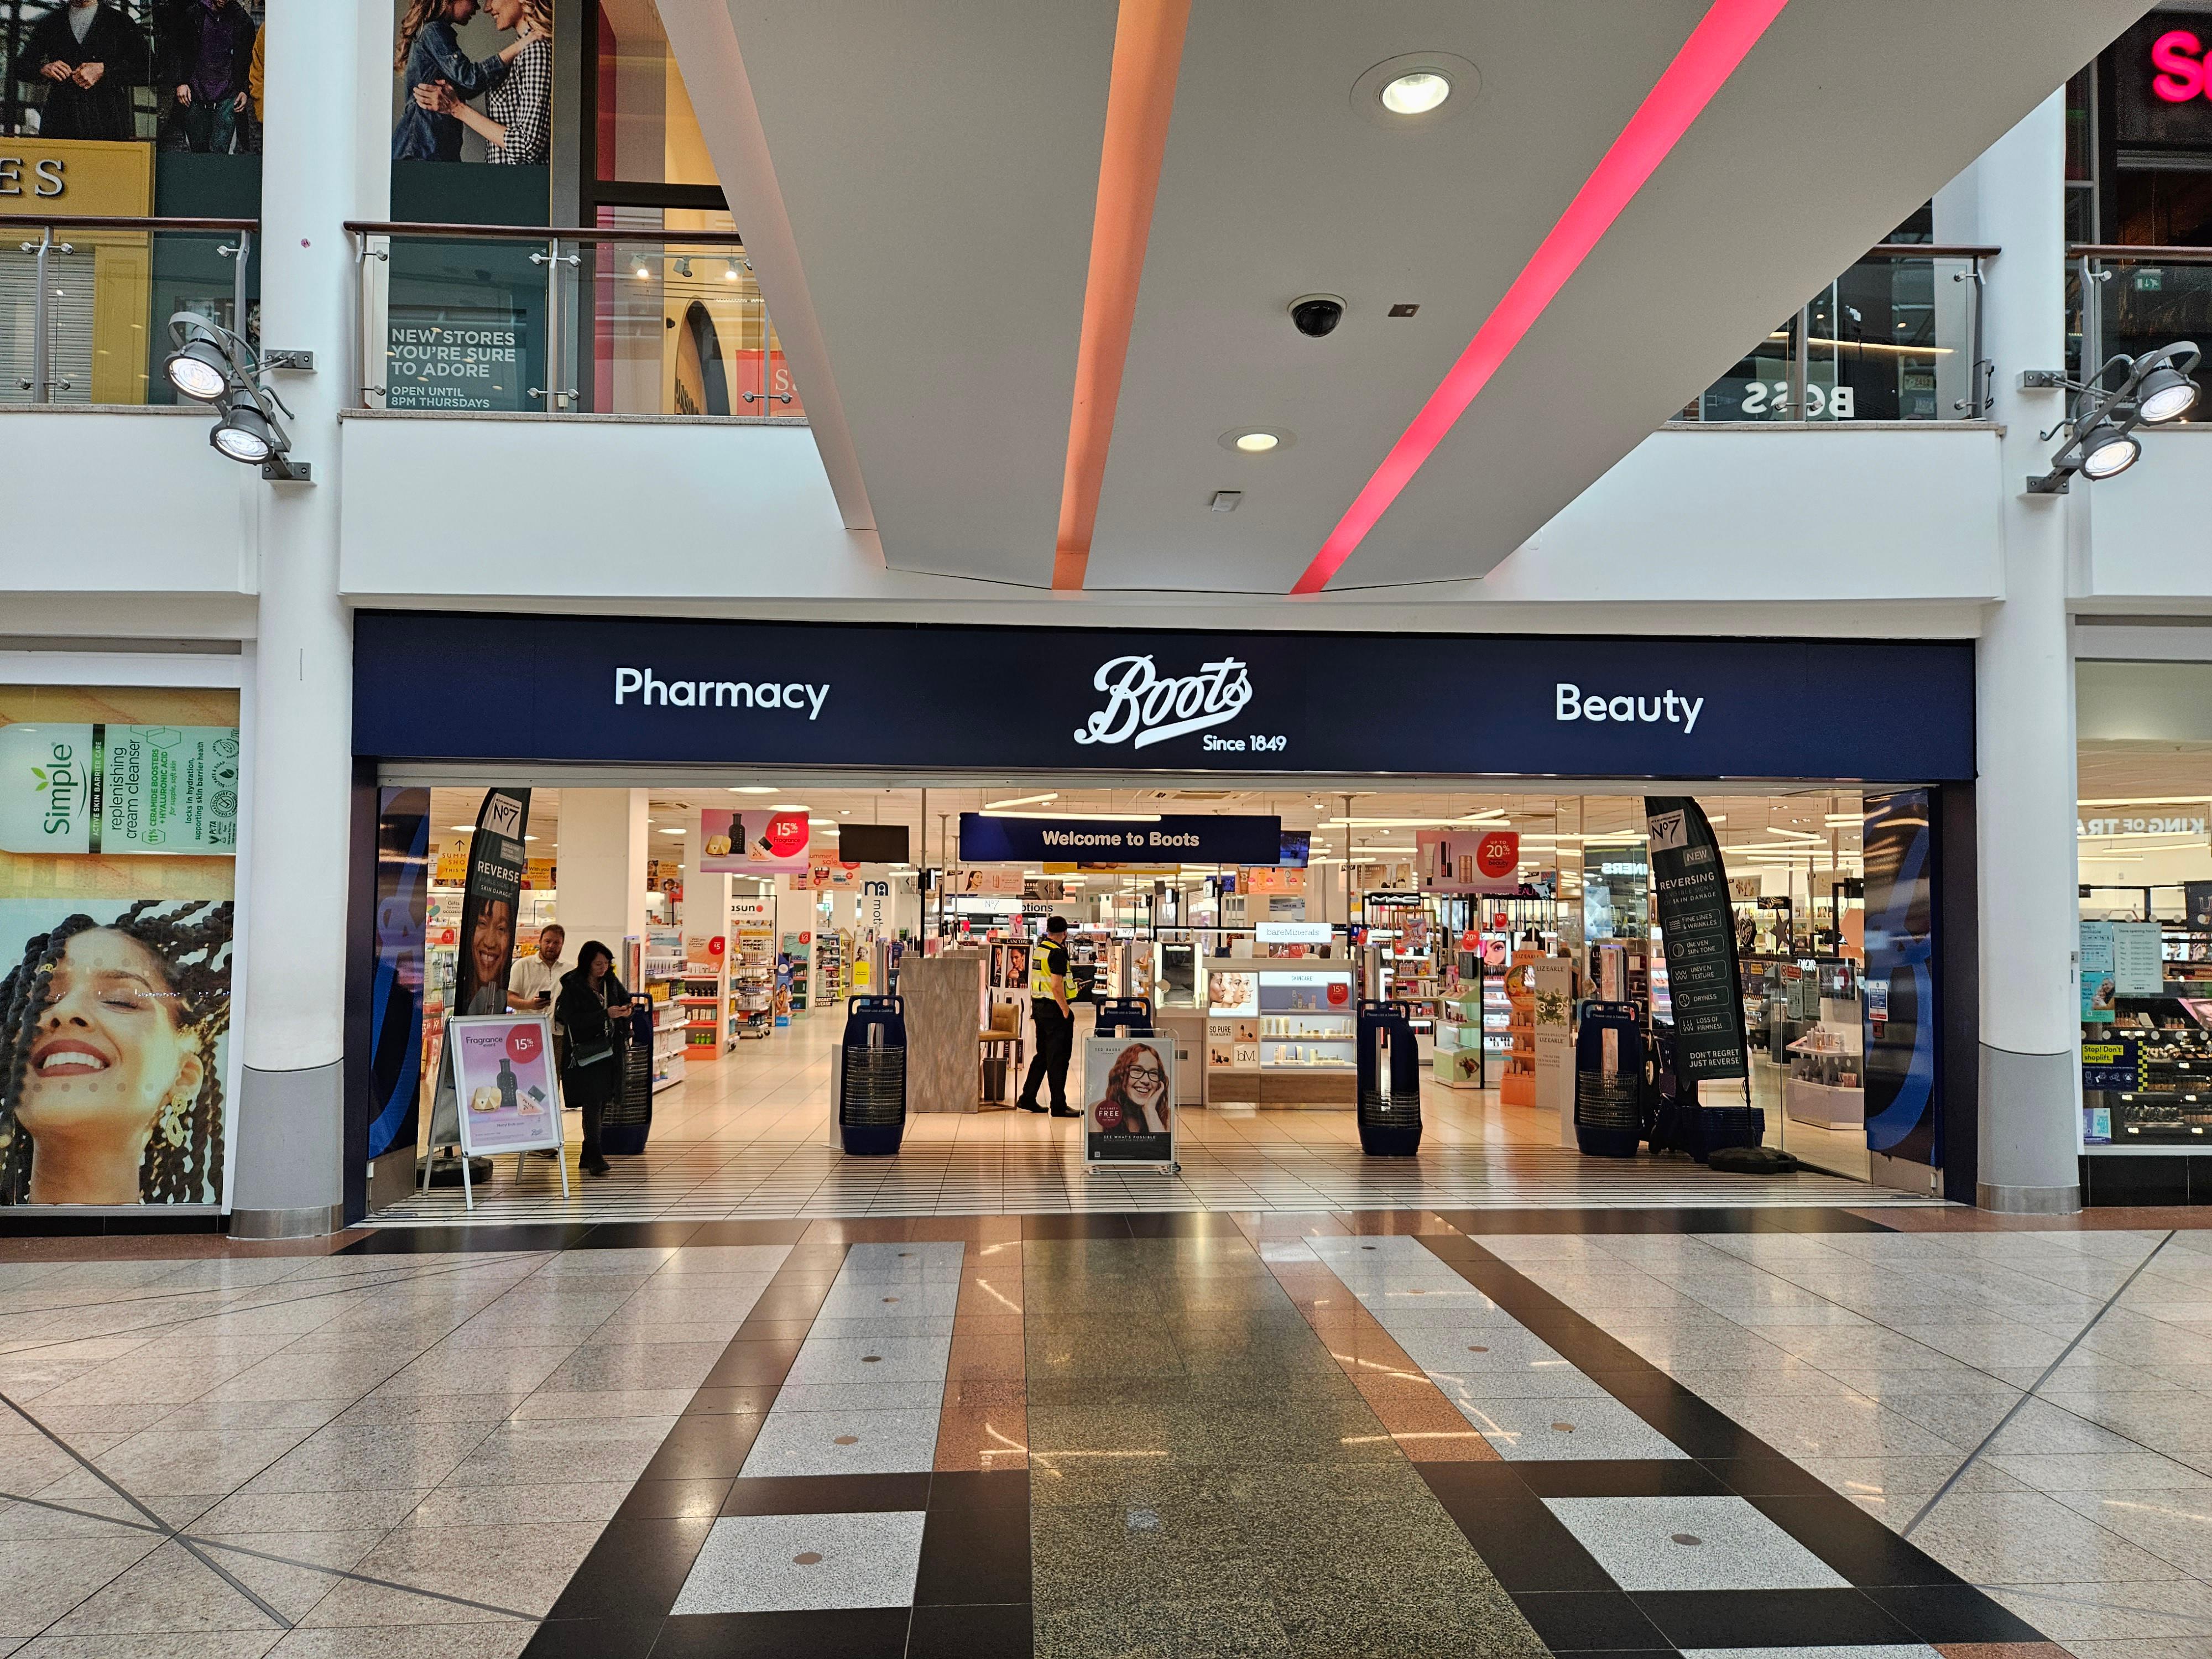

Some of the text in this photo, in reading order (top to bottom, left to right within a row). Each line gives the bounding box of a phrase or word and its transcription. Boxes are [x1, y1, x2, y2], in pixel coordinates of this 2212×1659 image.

[2151, 30, 2212, 101] S
[392, 328, 515, 346] NEW STORES
[392, 346, 515, 362] YOU'RE SURE
[392, 362, 490, 378] TO ADORE
[775, 369, 797, 392] S
[392, 386, 464, 397] OPEN UNTIL
[391, 397, 490, 408] 8PM THURSDAYS
[615, 667, 830, 721] Pharmacy
[1073, 654, 1253, 750] Boots
[1557, 683, 1704, 734] Beauty
[1203, 734, 1287, 752] Since 1849
[186, 757, 195, 795] hydration,
[44, 744, 79, 834] Simple
[109, 747, 127, 830] replenishing
[125, 739, 140, 839] cream cleanser
[159, 769, 168, 819] HYALURONIC
[195, 806, 204, 840] supporting
[149, 828, 158, 842] 11%
[1042, 831, 1200, 847] Welcome to Boots
[1687, 849, 1707, 862] NEW
[477, 860, 519, 883] REVERSE
[1660, 872, 1714, 891] REVERSING
[493, 888, 512, 898] DAMAGE
[1690, 892, 1717, 901] DAMAGE
[1687, 920, 1717, 929] WRINKLES
[1696, 913, 1713, 921] LINES
[1691, 965, 1712, 973] UNEVEN
[1538, 1001, 1546, 1013] 3
[1556, 1003, 1564, 1014] 2
[466, 1036, 503, 1045] Fragrance
[514, 1039, 534, 1050] 15%
[1236, 1050, 1256, 1061] bM
[1689, 1057, 1740, 1067] JUST REVERSE
[1690, 1048, 1739, 1060] DON'T REGRET
